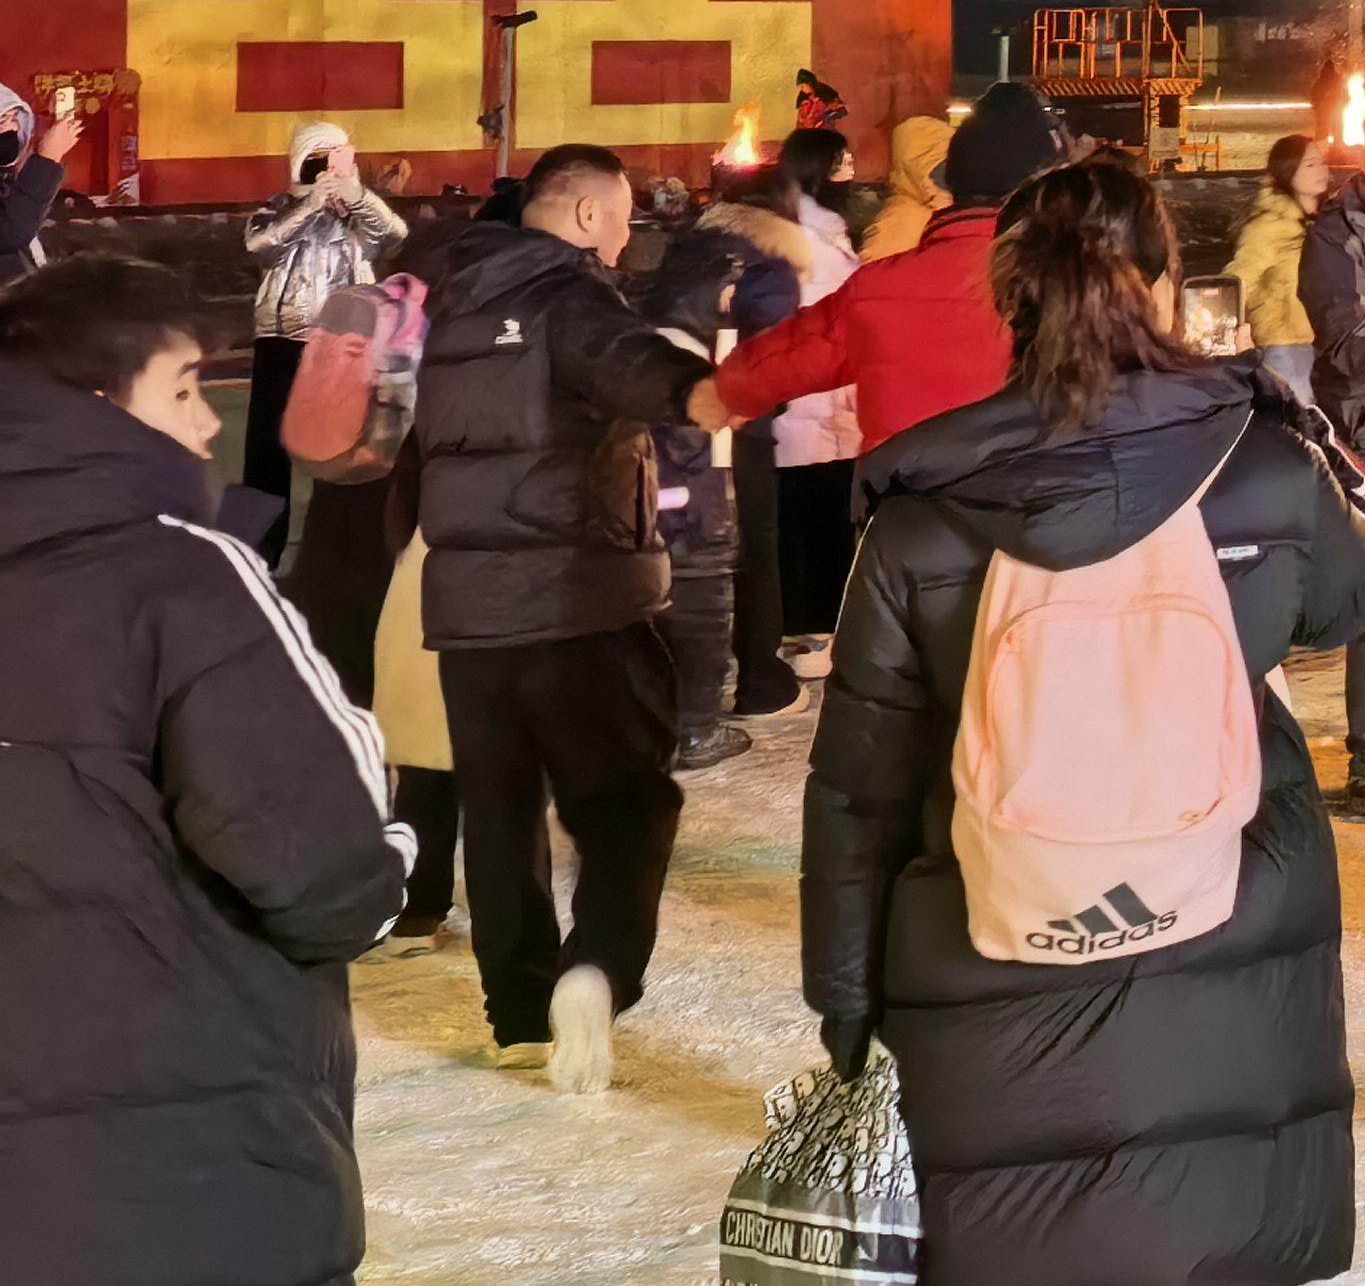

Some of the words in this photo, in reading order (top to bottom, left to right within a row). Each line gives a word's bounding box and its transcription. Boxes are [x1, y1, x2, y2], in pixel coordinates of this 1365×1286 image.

[1025, 910, 1178, 955] adidas
[725, 1211, 796, 1258] CHRSTIAN
[799, 1225, 844, 1265] DIOR
